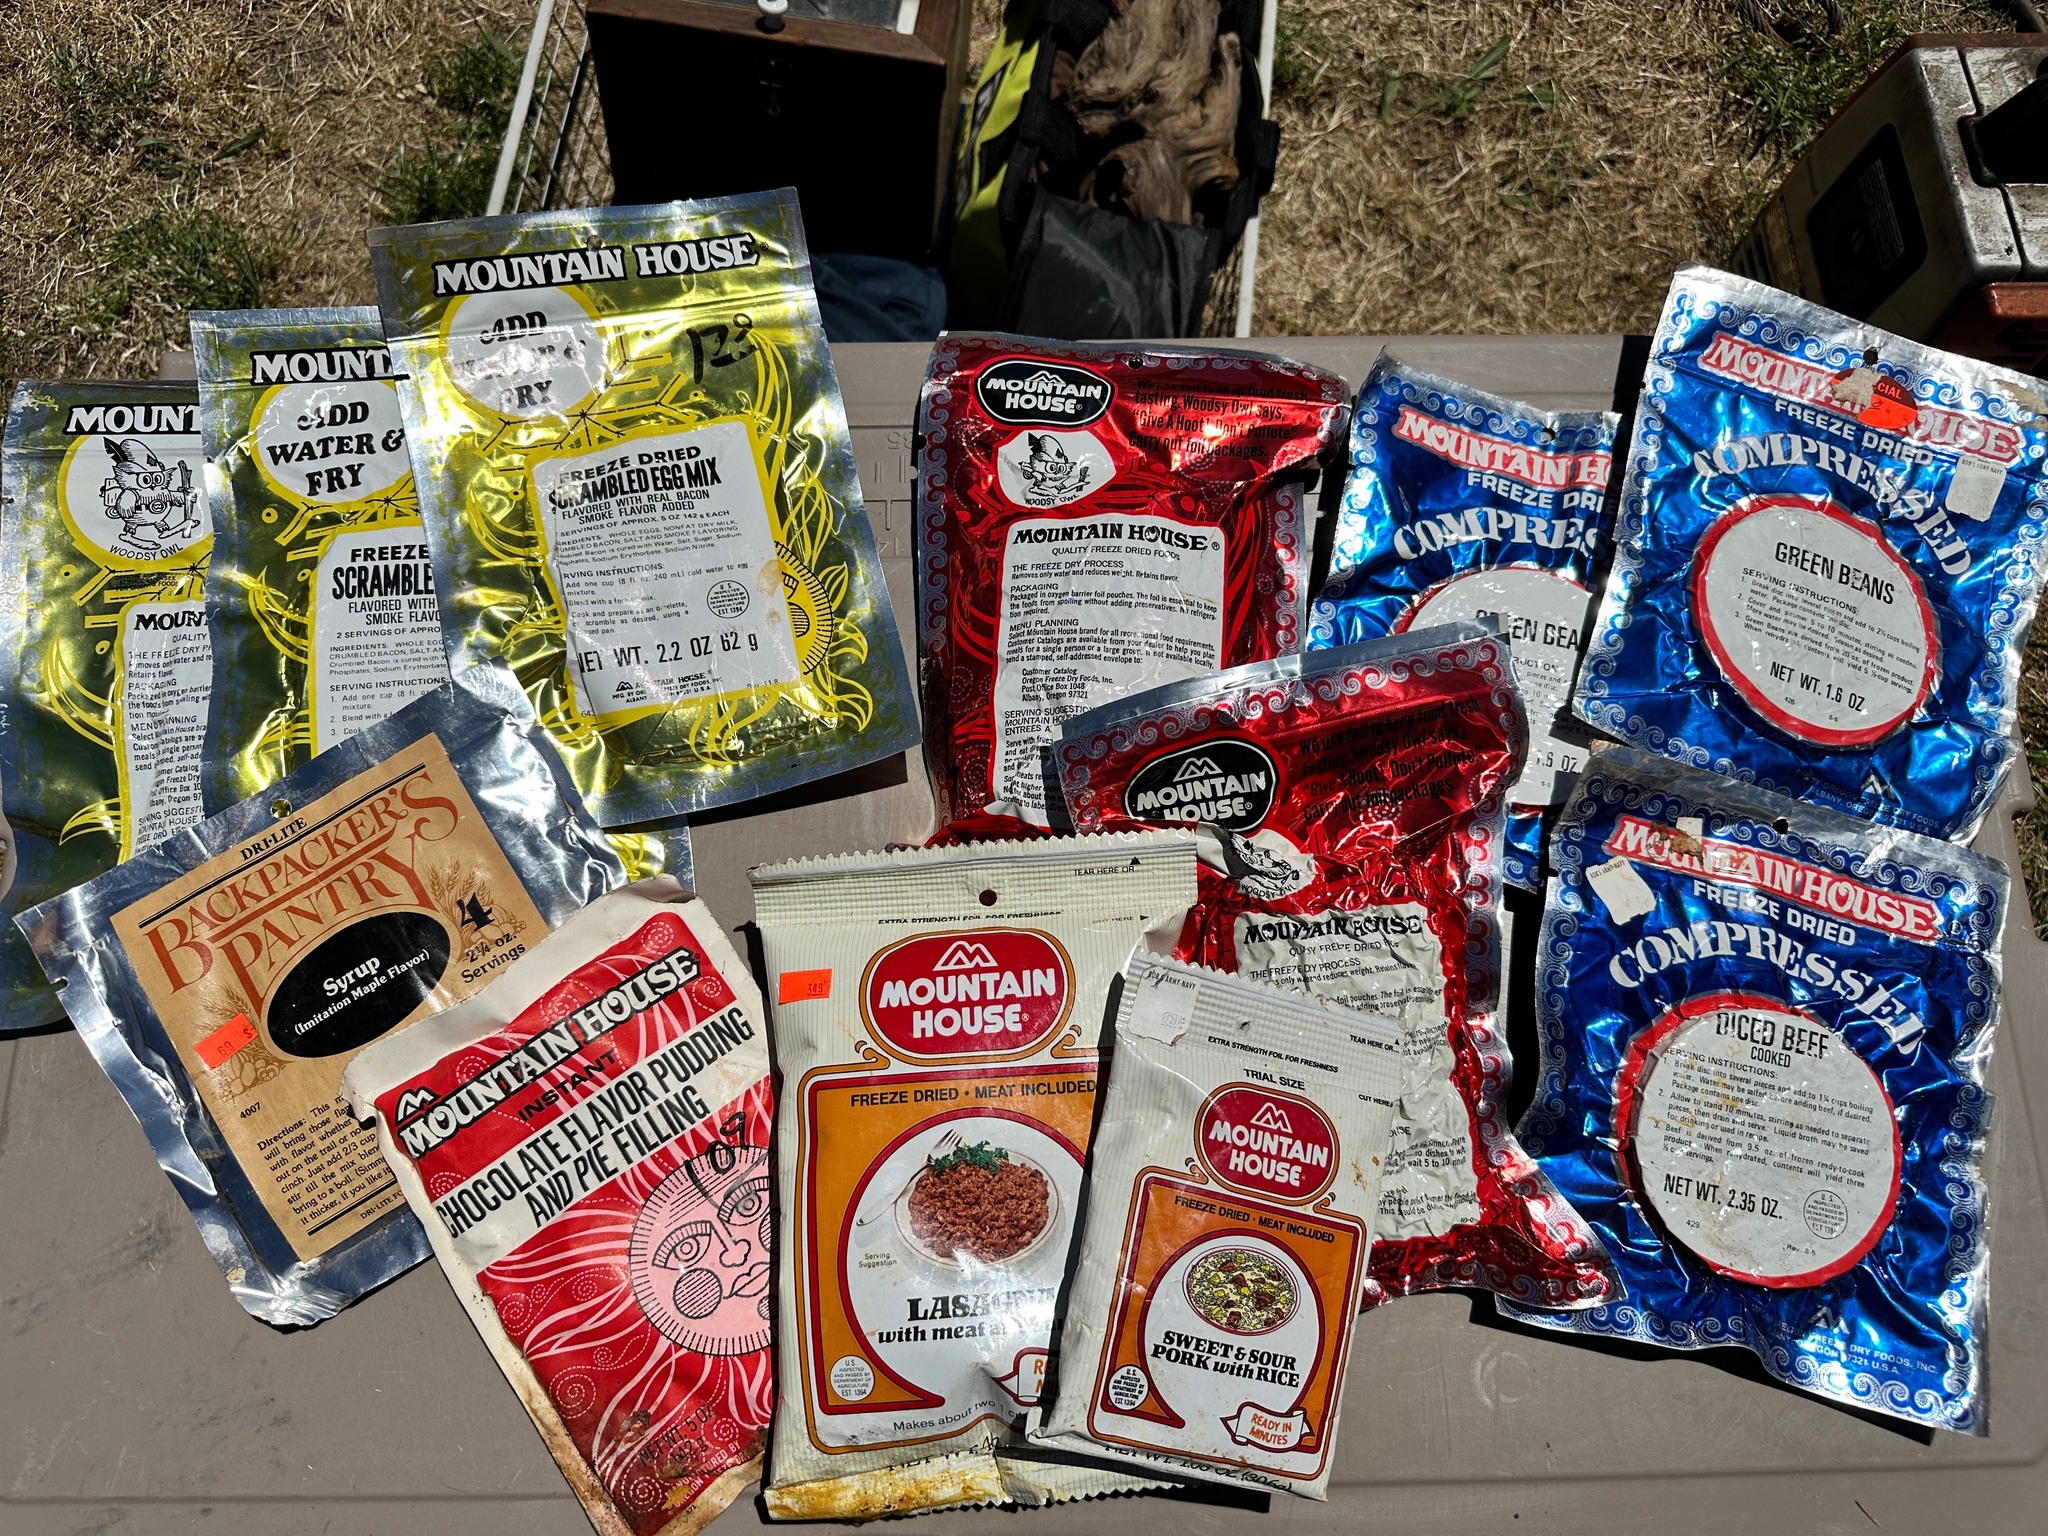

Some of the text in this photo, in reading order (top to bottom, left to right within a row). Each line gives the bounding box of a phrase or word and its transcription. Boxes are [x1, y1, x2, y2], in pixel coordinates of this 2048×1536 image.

[435, 234, 758, 295] MOUNTAIN HOUSE
[480, 311, 548, 346] ADD
[253, 349, 393, 383] MOUNT
[500, 380, 553, 410] FRY
[985, 377, 1103, 400] MOUNTAIN
[1004, 394, 1077, 415] HOUSE
[297, 401, 370, 430] ADD
[1183, 395, 1228, 416] Woodsy
[266, 428, 405, 466] WATER &
[1399, 409, 1569, 487] MOUNTAIN
[1774, 399, 1933, 465] FREEZE DRIED
[306, 463, 365, 496] FRY
[559, 446, 701, 484] FREEZE DRIED
[651, 464, 685, 492] EGG
[686, 457, 722, 488] MIX
[562, 489, 710, 520] FLAVORED WITH REAL BACON
[1467, 470, 1554, 511] FREEZE
[1694, 431, 1972, 577] COMPRESSED
[579, 501, 695, 525] SMOKE FLAVOR ADDED
[560, 525, 605, 537] SERVINGS
[1012, 523, 1208, 551] MOUNTAIN HOUSE
[110, 543, 184, 561] WOODSY OWL
[351, 545, 429, 562] FREEZE
[1012, 564, 1028, 572] THE
[1031, 562, 1062, 570] FREEZE
[1065, 561, 1082, 569] DRY
[1052, 547, 1088, 556] QUALITY
[1125, 546, 1151, 555] DRIED
[332, 562, 436, 600] SCRAMBLE
[1010, 583, 1059, 593] PACKAGING
[1742, 567, 1786, 588] SERVING
[1775, 541, 1895, 605] GREEN BEANS
[349, 598, 435, 613] FLAVORED WITH
[366, 612, 403, 625] SMOKE
[172, 633, 207, 643] QUALITY
[345, 628, 392, 638] SERVINGS
[1009, 618, 1079, 632] MENU PLANNING
[614, 646, 648, 667] WT.
[657, 641, 682, 663] 2.2
[690, 635, 712, 657] OZ
[720, 631, 741, 651] 62
[330, 682, 373, 692] SERVING
[1045, 675, 1065, 683] Freeze
[1053, 668, 1077, 676] Catalog
[1770, 661, 1866, 712] NET WT. 1.6 OZ
[1005, 708, 1041, 718] SERVING
[1005, 717, 1050, 726] MOUNTAIN
[1005, 726, 1041, 736] ENTREES
[1136, 769, 1268, 813] MOUNTAIN
[1164, 795, 1246, 822] HOUSE
[1073, 868, 1094, 876] TEAR
[1121, 866, 1134, 874] OR
[458, 892, 495, 935] 4
[1693, 879, 1856, 947] FREEZE DRIED
[1800, 869, 1936, 937] HOUSE
[215, 832, 441, 1017] PANTRY
[322, 954, 382, 997] Syrup
[460, 940, 527, 984] Servings
[293, 947, 431, 1036] (Imitation Maple Flavor)
[878, 967, 1056, 1009] MOUNTAIN
[1609, 920, 1927, 1056] COMPRESSED
[911, 1005, 1023, 1039] HOUSE
[1716, 1012, 1829, 1059] DICED BEEF
[400, 948, 700, 1159] MOUNTAIN HOUSE
[1208, 1036, 1339, 1073] EXTRA STRENGTH FOIL FOR FRESHNESS
[1707, 1056, 1778, 1079] INSTRUCTIONS:
[1750, 1046, 1791, 1068] COOKED
[516, 1047, 617, 1123] INSTANT
[851, 1079, 1096, 1107] FREEZE DRIED MEAT INCLUDED
[1243, 1068, 1306, 1091] TRIAL SIZE
[240, 1102, 261, 1119] 4007
[1358, 1094, 1372, 1102] CUT
[257, 1103, 330, 1151] Directions: This
[291, 1118, 352, 1159] flavor whether
[436, 1006, 756, 1239] CHOCOLATE FLAVOR PUDDING
[308, 1133, 376, 1178] Just add 2/3 cup
[527, 1083, 711, 1228] AND PIE FILLING
[1208, 1119, 1329, 1168] MOUNTAIN
[1228, 1152, 1302, 1187] HOUSE
[1664, 1173, 1782, 1219] NET WT. 2.35 OZ.
[1174, 1195, 1335, 1243] FREEZE DRIED MEAT INCLUDED
[1686, 1219, 1700, 1228] 429
[858, 1258, 897, 1268] Suggestion
[864, 1252, 890, 1261] Serving
[878, 1326, 927, 1344] with
[932, 1322, 985, 1341] meat
[1150, 1343, 1300, 1388] PORK with RICE
[1163, 1330, 1297, 1371] SWEET & SOUR
[893, 1401, 996, 1432] Makes about two
[1251, 1413, 1292, 1432] READY IN
[639, 1425, 687, 1467] NET WT.
[1249, 1426, 1288, 1445] MINUTES
